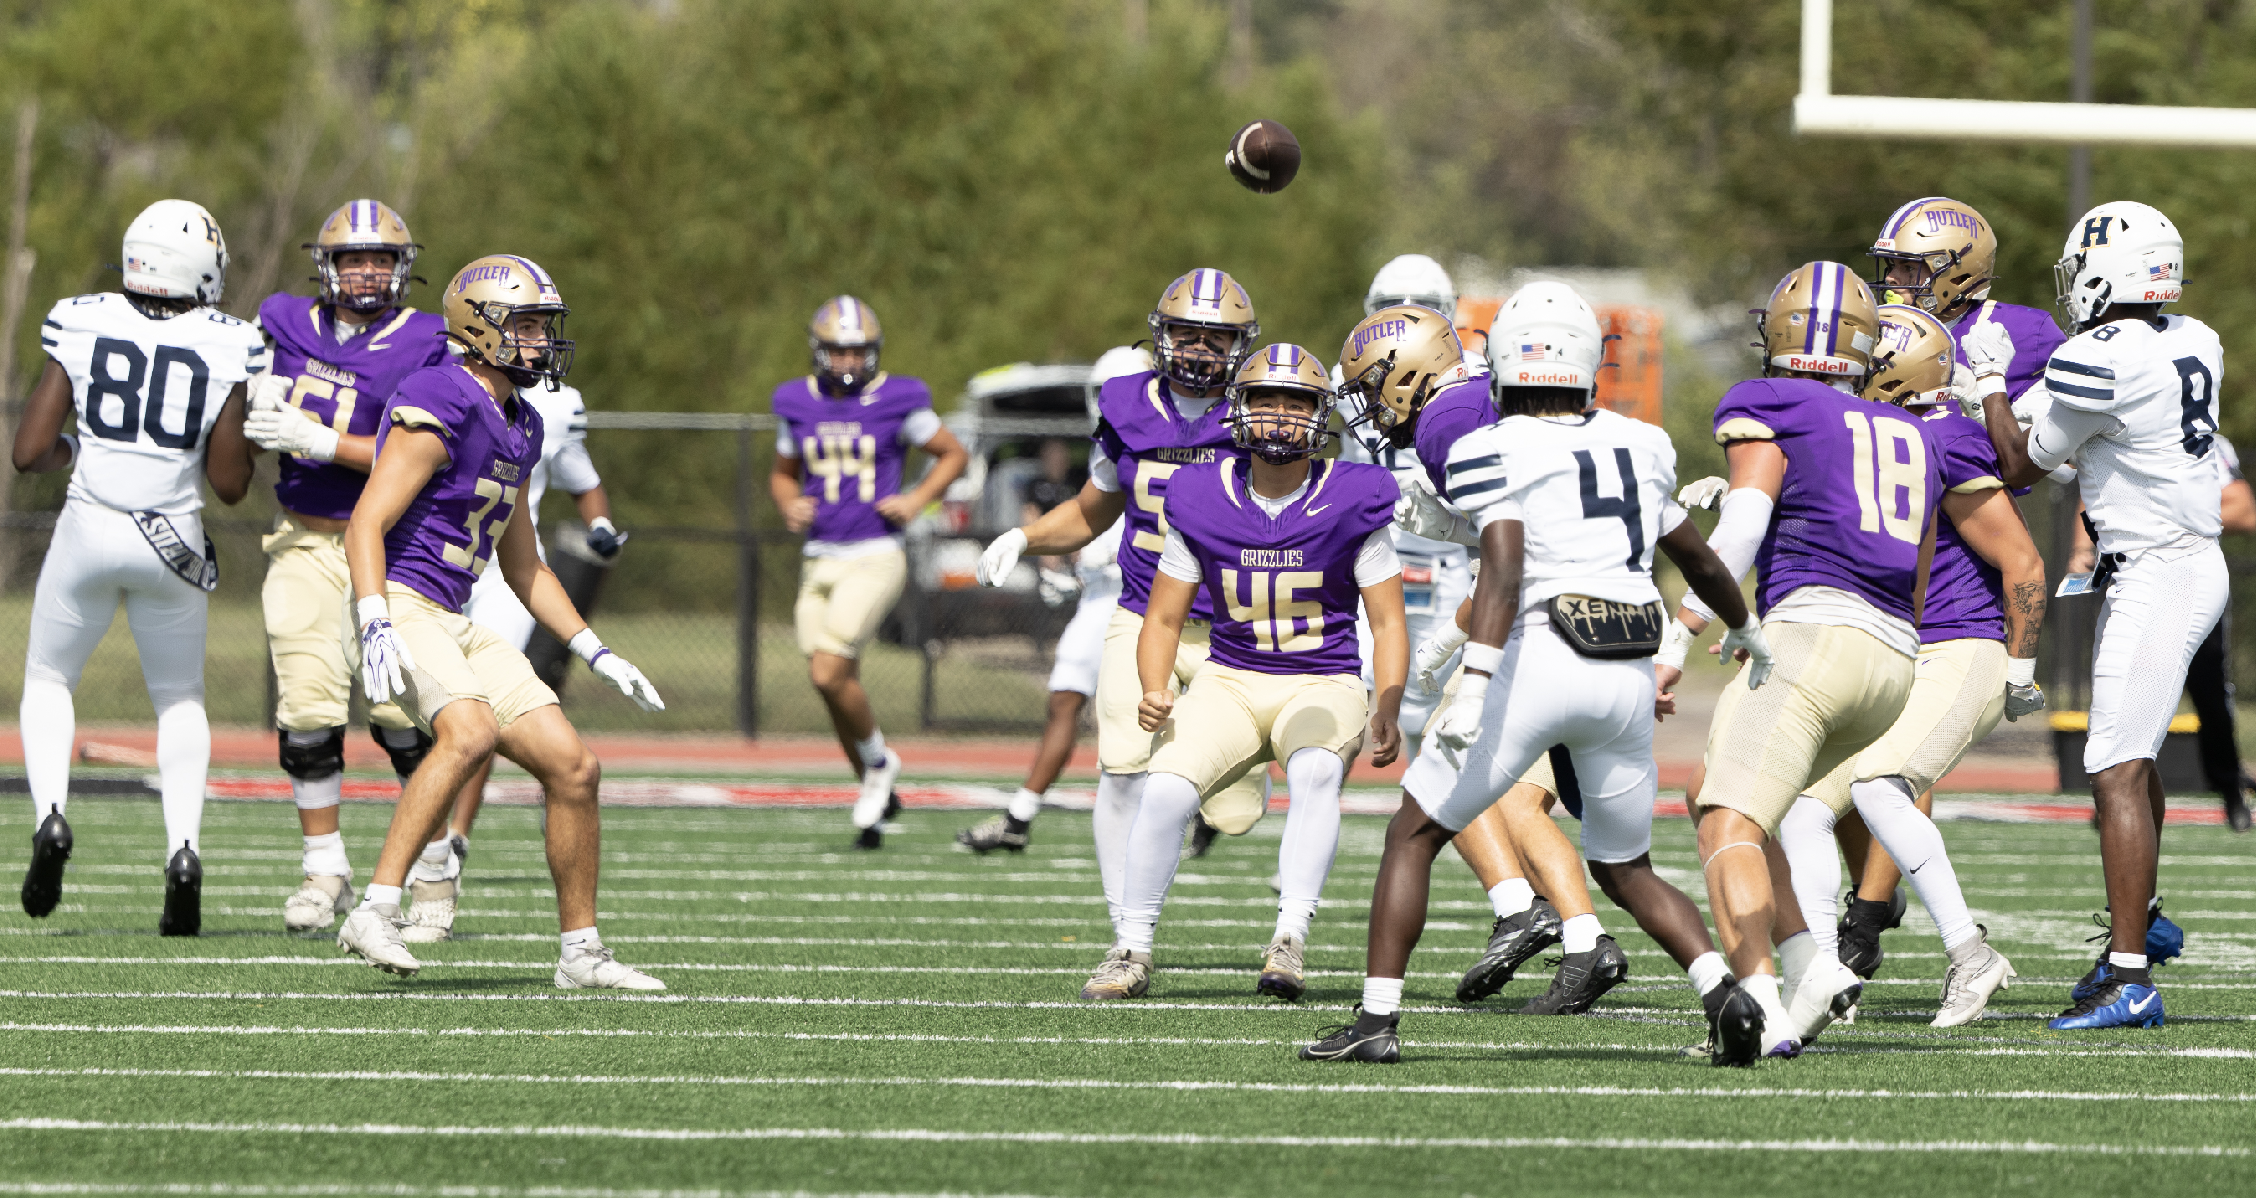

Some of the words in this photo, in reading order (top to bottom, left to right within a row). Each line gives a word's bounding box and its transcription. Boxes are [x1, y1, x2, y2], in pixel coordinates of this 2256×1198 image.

[1925, 210, 1978, 239] BUTLER
[2080, 215, 2116, 251] H
[458, 265, 511, 294] BUTLER
[1353, 319, 1407, 357] BUTLER
[1817, 321, 1829, 332] 18
[2092, 325, 2121, 342] 8
[1519, 371, 1578, 385] Riddell
[1790, 356, 1849, 373] Riddell
[86, 336, 210, 449] 80
[2172, 355, 2217, 460] 8
[803, 434, 876, 504] 44
[1157, 447, 1216, 464] GRIZZLIES
[1843, 410, 1927, 546] 18
[442, 477, 519, 576] 33
[1571, 448, 1645, 572] 4
[1240, 548, 1303, 568] GRIZZLIES
[1221, 568, 1325, 653] 46
